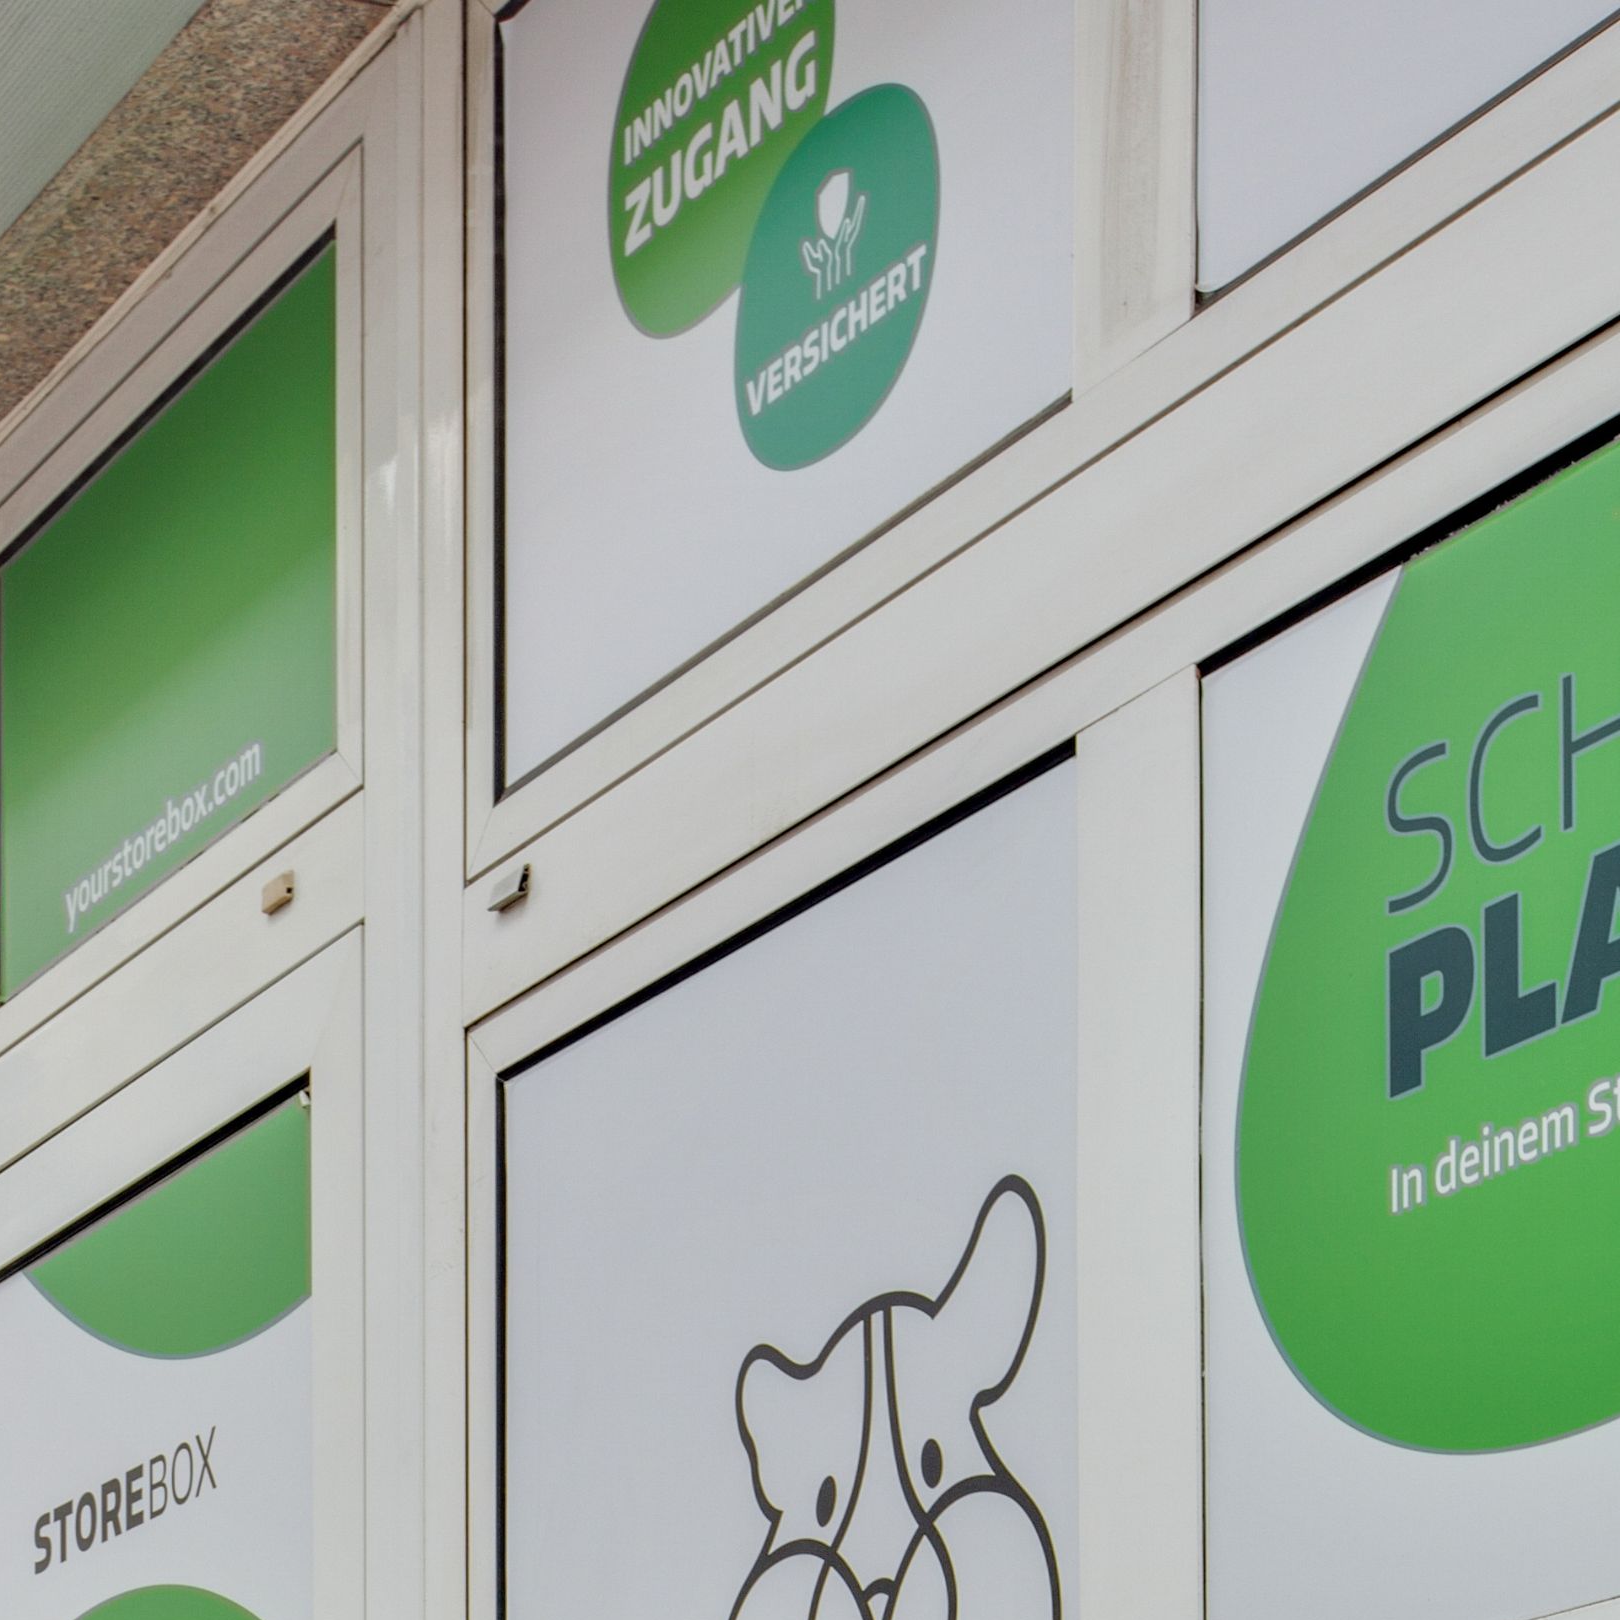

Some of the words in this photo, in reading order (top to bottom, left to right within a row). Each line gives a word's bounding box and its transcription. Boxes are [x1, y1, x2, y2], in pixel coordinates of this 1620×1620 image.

[624, 0, 803, 167] INNOVATIVE
[624, 30, 816, 257] ZUGANG
[746, 243, 928, 416] VERSICHERT
[64, 742, 262, 934] yourstorebox.com
[1390, 1166, 1423, 1214] In
[1434, 1104, 1575, 1196] deinem
[34, 1424, 217, 1575] STOREBOX
